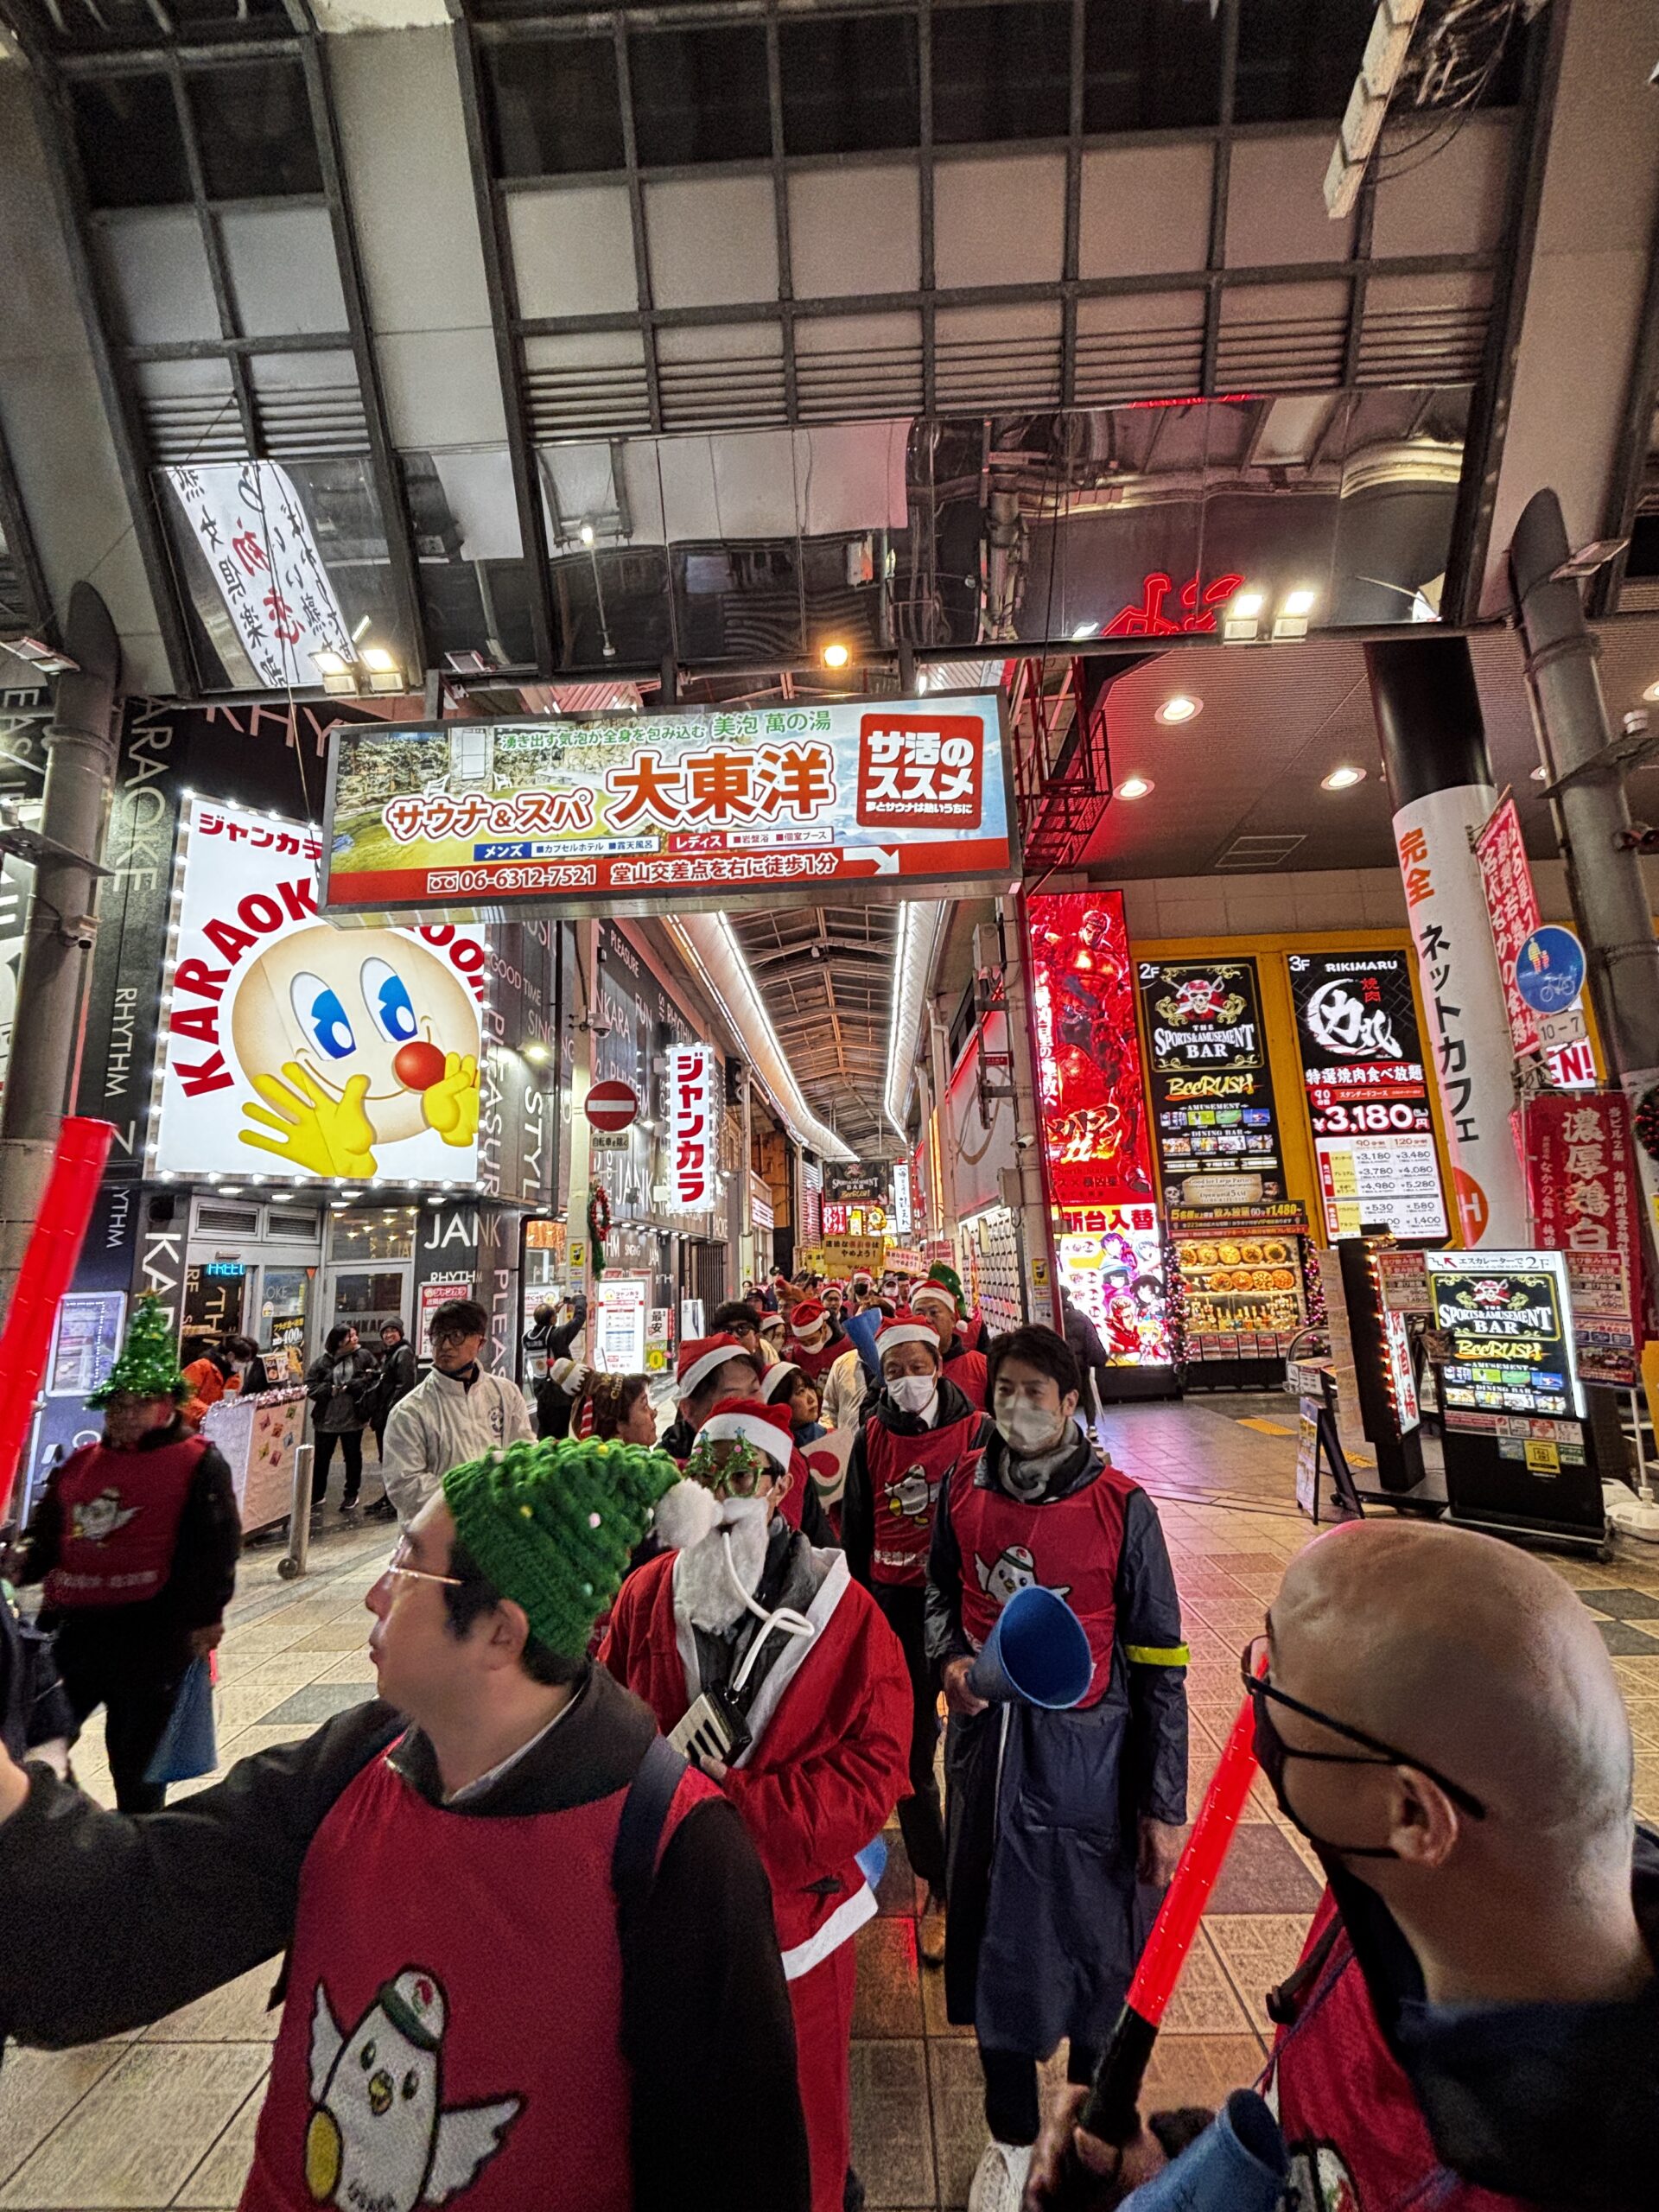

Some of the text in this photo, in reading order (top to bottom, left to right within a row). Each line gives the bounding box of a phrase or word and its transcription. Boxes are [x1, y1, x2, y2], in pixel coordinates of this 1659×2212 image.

[714, 709, 831, 736] 美泡 萬の湯
[501, 724, 706, 750] 湧き出す気泡が全身を包み込む
[868, 731, 974, 767] サ活の
[391, 747, 830, 839] サウナ&スパ 大東洋
[866, 767, 974, 800] ススメ
[199, 813, 322, 860] ジャンカラ
[543, 840, 654, 854] カプセルホテル 露天風呂
[676, 836, 722, 849] レディス
[741, 830, 828, 844] 岩盤浴 個室ブース
[484, 844, 524, 858] メンズ
[461, 854, 838, 889] 06-6312-7521 堂山交差点を右に徒歩1分
[610, 930, 640, 978] PLEASURE
[1289, 956, 1310, 971] 3F
[1325, 960, 1398, 973] RIKIMARU
[490, 952, 543, 1006] GOOD TIME
[1139, 963, 1160, 979] 2F
[168, 877, 319, 1097] KARAOK
[1360, 978, 1381, 1002] 焼肉
[1399, 827, 1479, 1143] 完全 ネットカフェ
[105, 988, 137, 1097] RHYTHM
[1186, 1044, 1228, 1058] BAR
[1306, 1065, 1424, 1084] 特選焼肉食べ放題
[1314, 1090, 1331, 1099] 90
[677, 1052, 705, 1203] ジャンカラ
[592, 1136, 629, 1147] 自転車を除く
[1459, 1256, 1549, 1269] エスカレーターで 2F
[1439, 1304, 1553, 1331] SPORTS&AMUSEMENT
[1473, 1320, 1520, 1334] BAR
